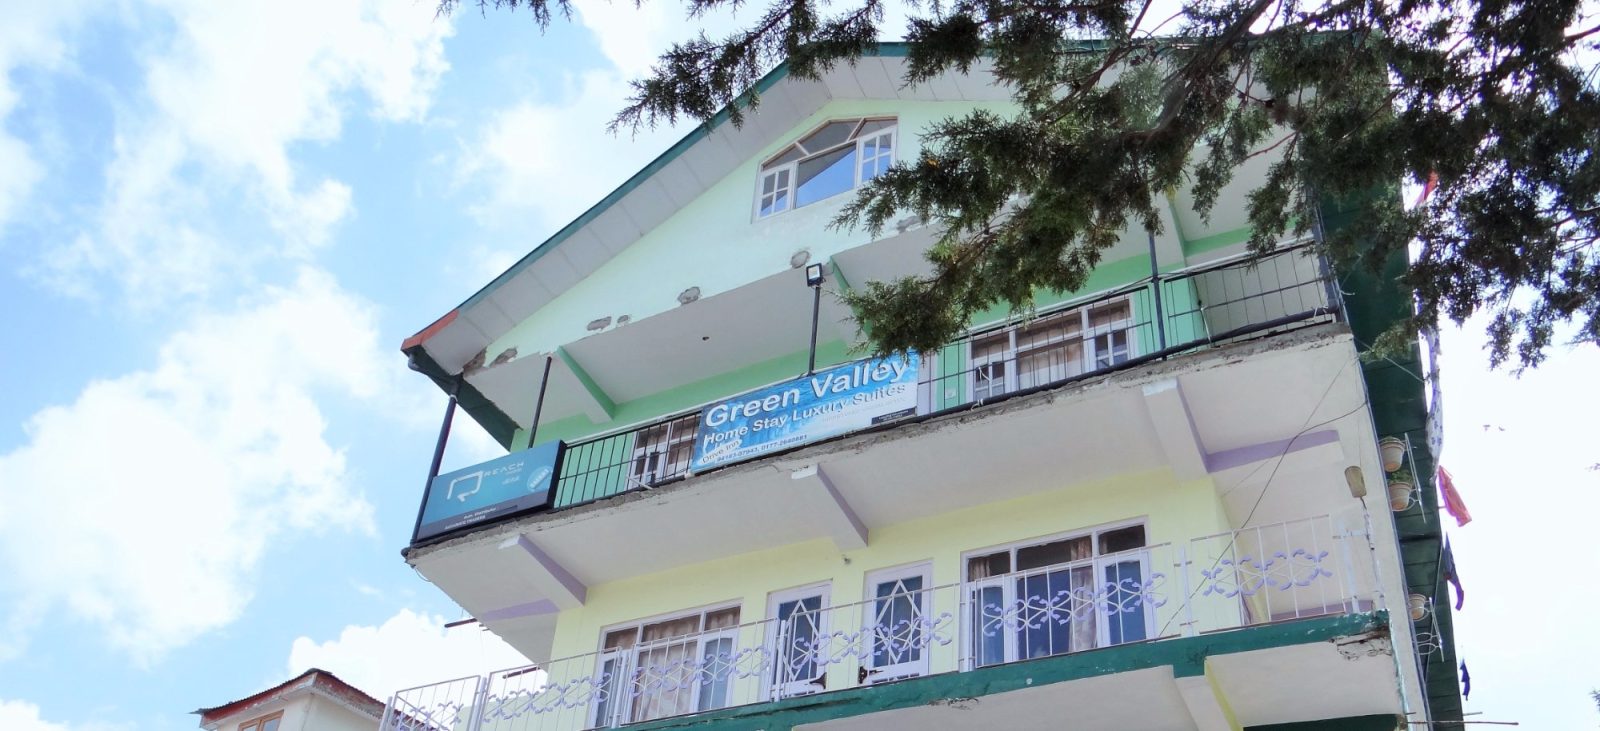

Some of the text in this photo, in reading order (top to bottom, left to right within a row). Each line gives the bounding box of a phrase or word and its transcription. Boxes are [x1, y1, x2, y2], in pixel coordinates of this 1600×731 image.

[703, 426, 748, 444] Home
[753, 416, 788, 433] Stay
[793, 400, 848, 421] Luxury
[853, 384, 906, 403] Suites
[705, 388, 799, 427] Green
[811, 360, 908, 398] Valley
[485, 461, 524, 475] REACH
[702, 440, 739, 464] Drive Inn
